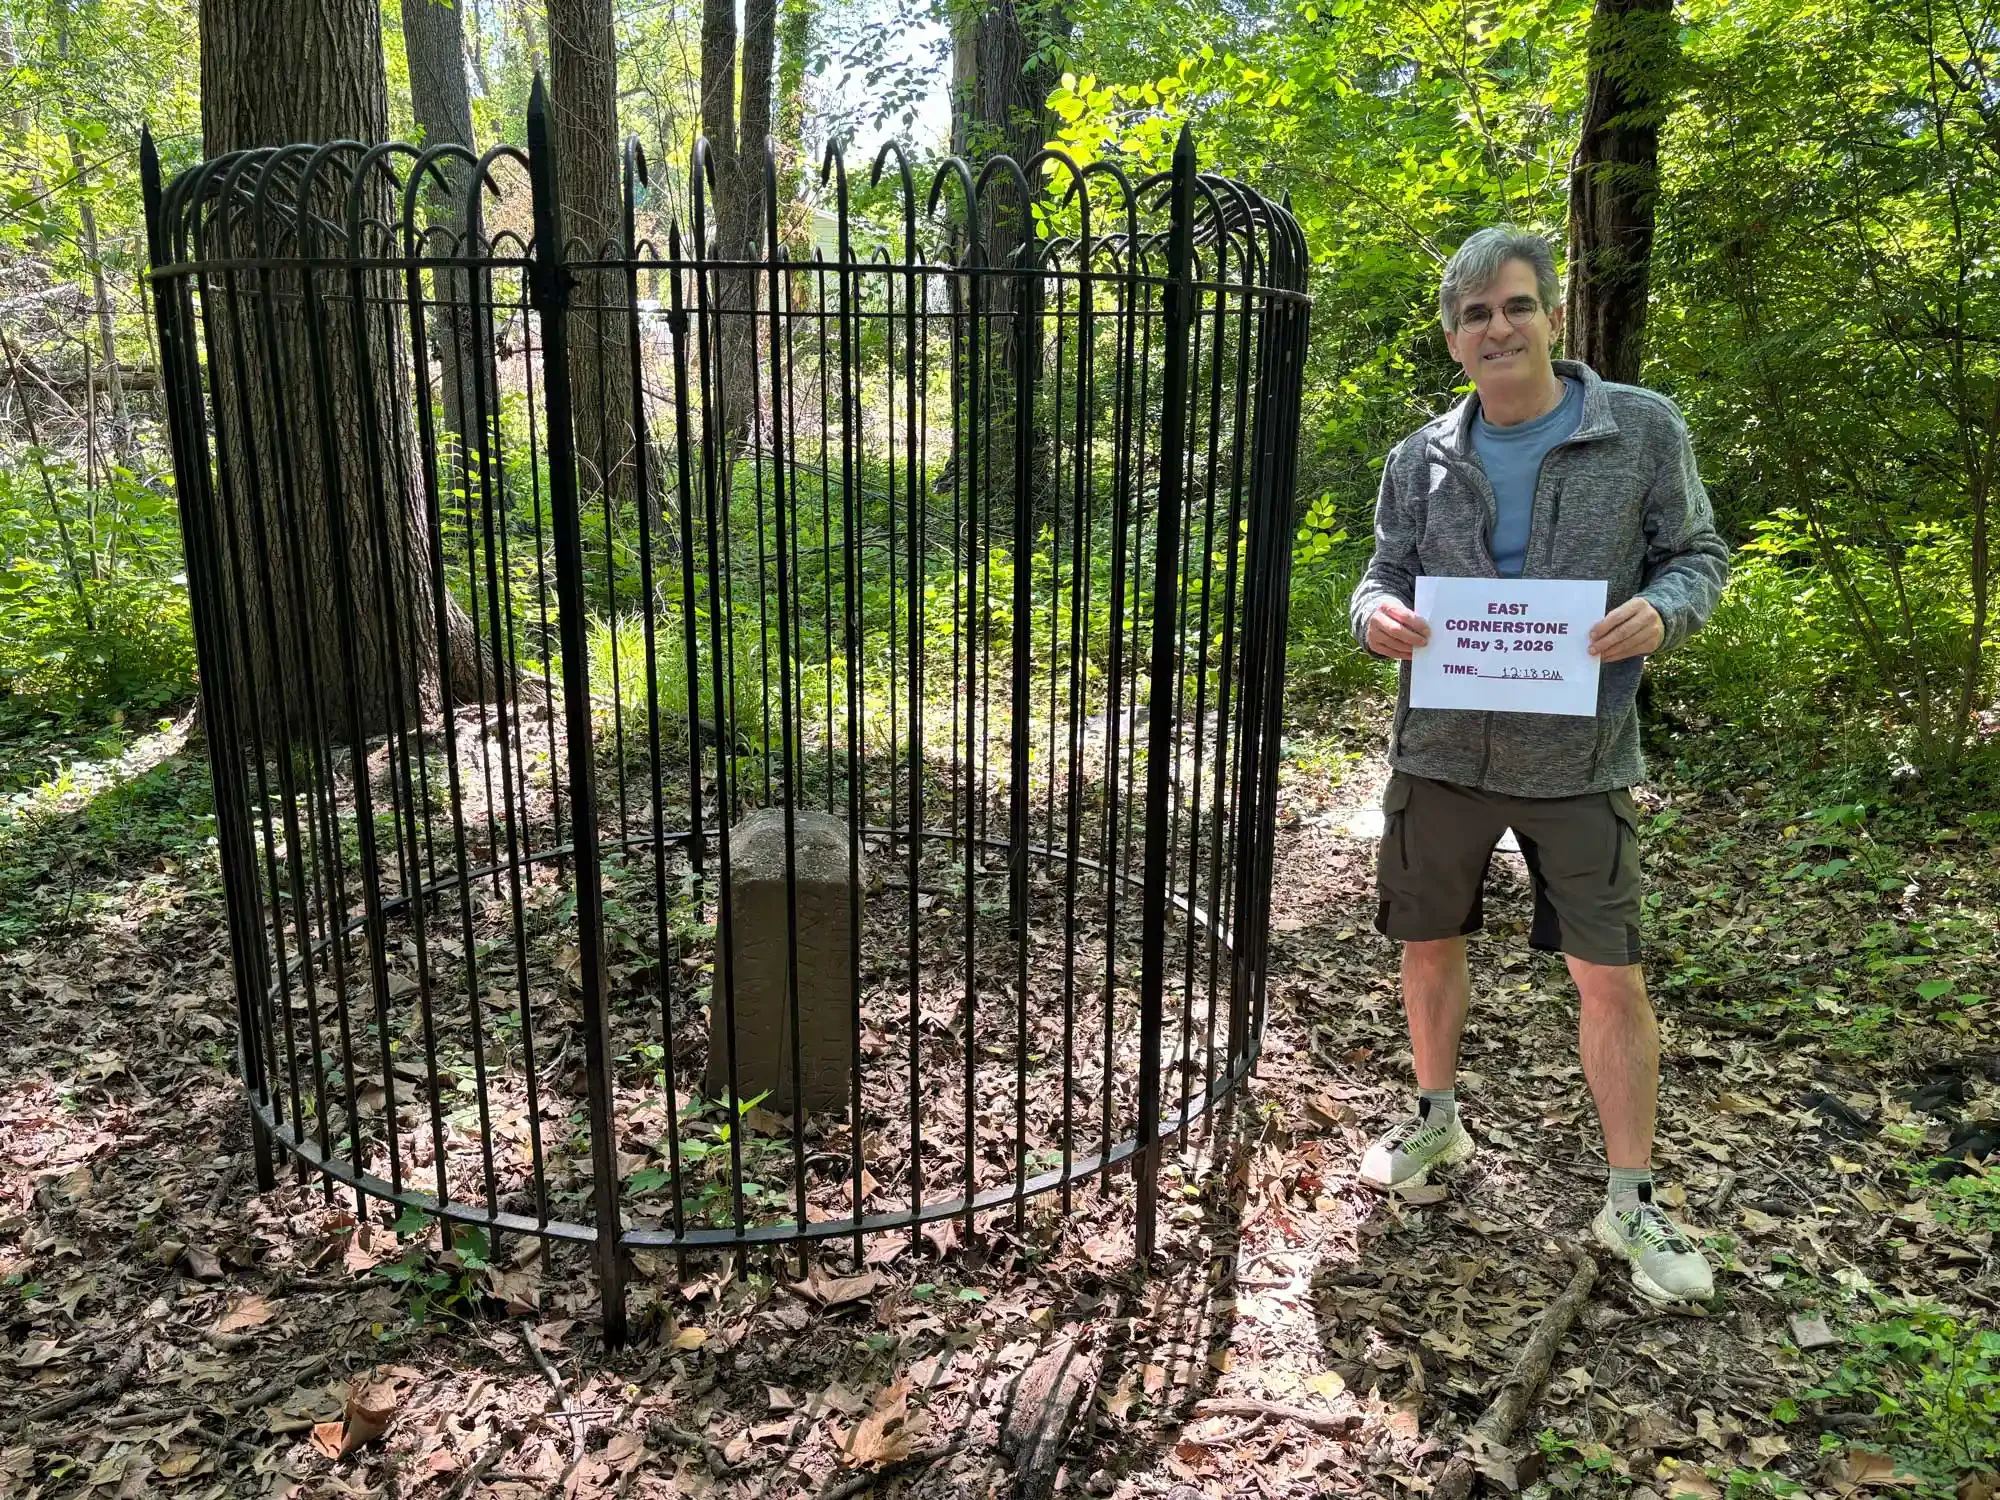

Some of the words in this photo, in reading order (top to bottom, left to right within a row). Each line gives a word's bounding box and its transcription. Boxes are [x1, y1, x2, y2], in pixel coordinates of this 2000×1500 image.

[1488, 603, 1528, 615] EAST
[1446, 620, 1568, 634] CORNERSTONE
[1457, 638, 1490, 652] May
[1494, 639, 1508, 653] 3,
[1513, 639, 1553, 651] 2026
[1443, 664, 1478, 675] TIME:
[1502, 667, 1538, 679] 12:18
